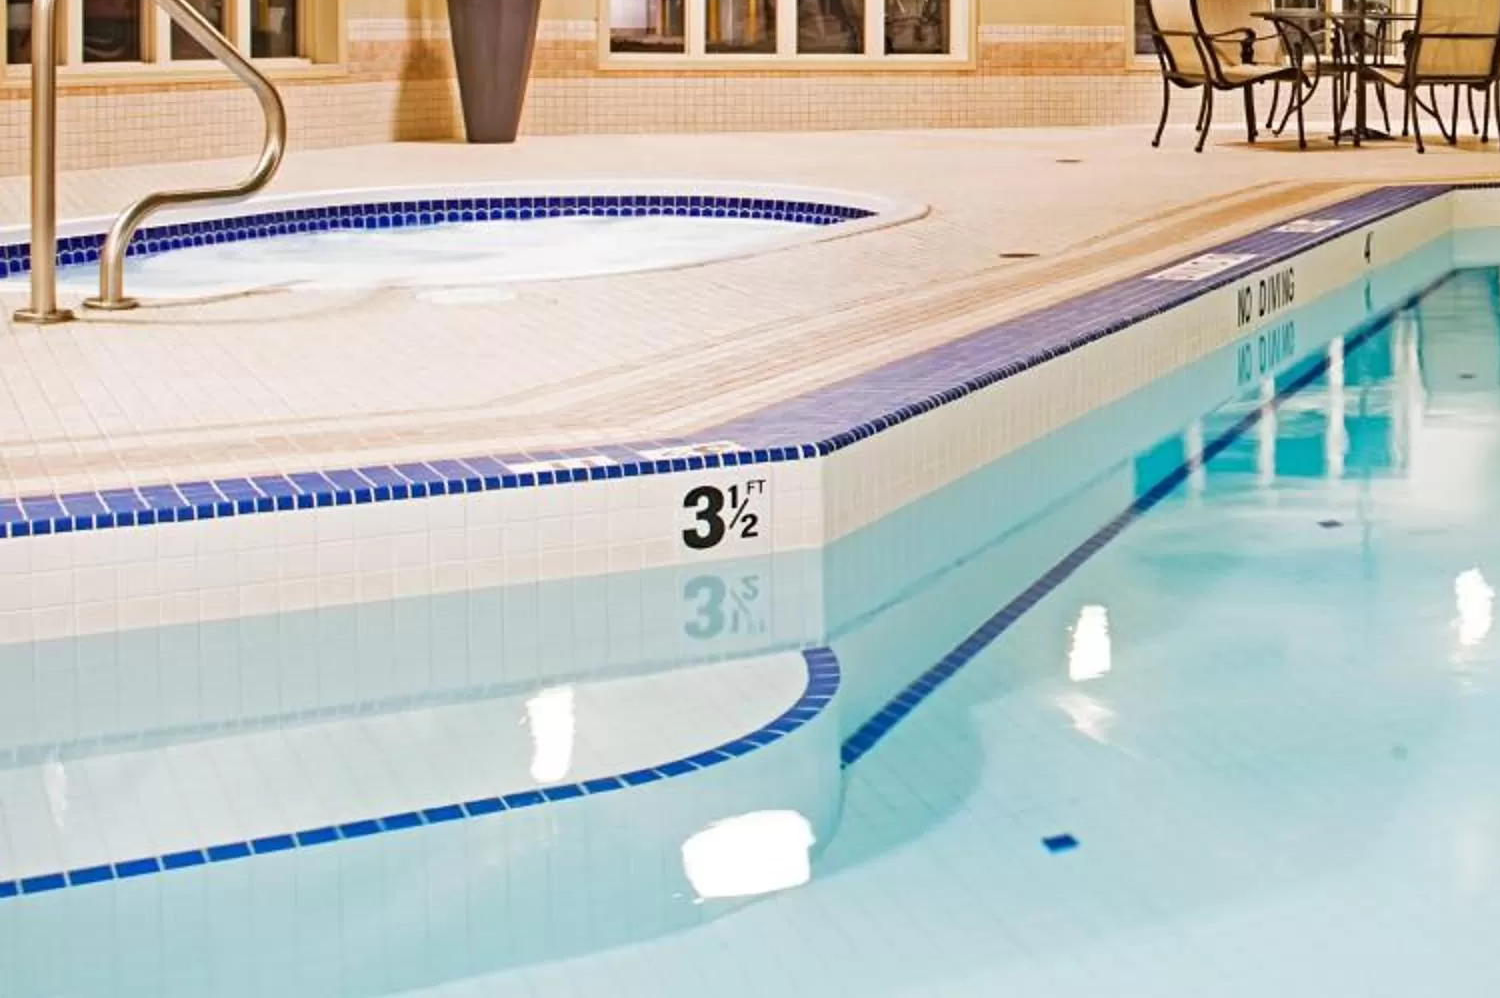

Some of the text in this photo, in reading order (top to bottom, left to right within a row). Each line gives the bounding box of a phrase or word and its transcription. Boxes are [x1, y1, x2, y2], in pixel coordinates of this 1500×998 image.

[1237, 286, 1252, 327] NO
[1259, 267, 1295, 317] DIVING
[746, 479, 766, 495] FT
